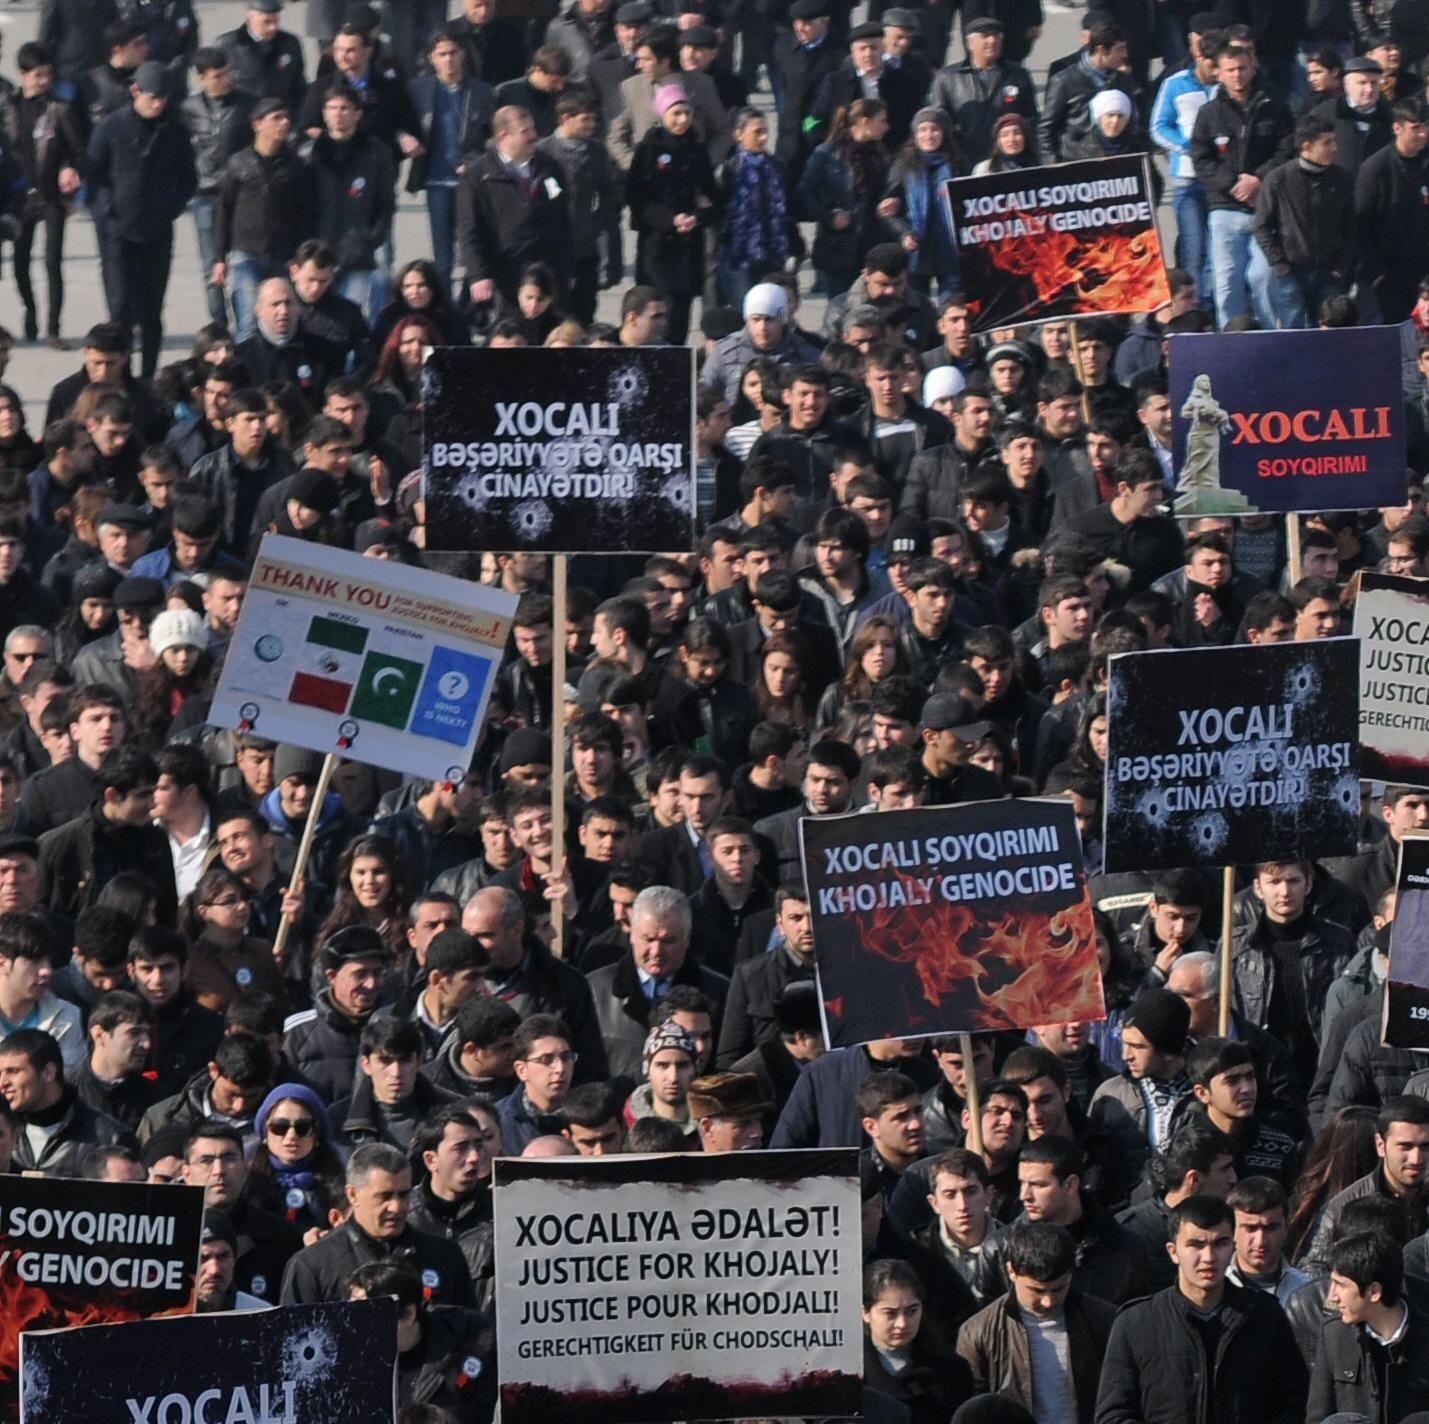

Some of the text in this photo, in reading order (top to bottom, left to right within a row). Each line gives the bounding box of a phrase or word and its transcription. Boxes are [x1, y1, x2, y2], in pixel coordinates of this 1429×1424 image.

[964, 176, 1138, 218] XOCALI SOYQIRIMI
[1052, 202, 1149, 231] GENOCIDE
[494, 402, 620, 436] XOCALI
[1231, 407, 1392, 444] XOCALI
[1258, 455, 1367, 477] SOYQIRIMI
[261, 564, 394, 610] THANK YOU
[1178, 704, 1294, 746] XOCALI
[824, 826, 1059, 874] XOCALI SOYQIRIMI
[819, 863, 1076, 915] KHOJALY GENOCIDE
[9, 1207, 176, 1246] SOYQIRIMI
[515, 1206, 841, 1247] XOCALIYA ƏDALƏT!
[17, 1252, 184, 1290] GENOCIDE
[519, 1249, 839, 1287] JUSTICE FOR KHOJALY!
[520, 1291, 839, 1325] JUSTICE POUR KHODJALI!
[518, 1328, 843, 1359] GERECHTIGKEIT FÜR CHODSCHALI!
